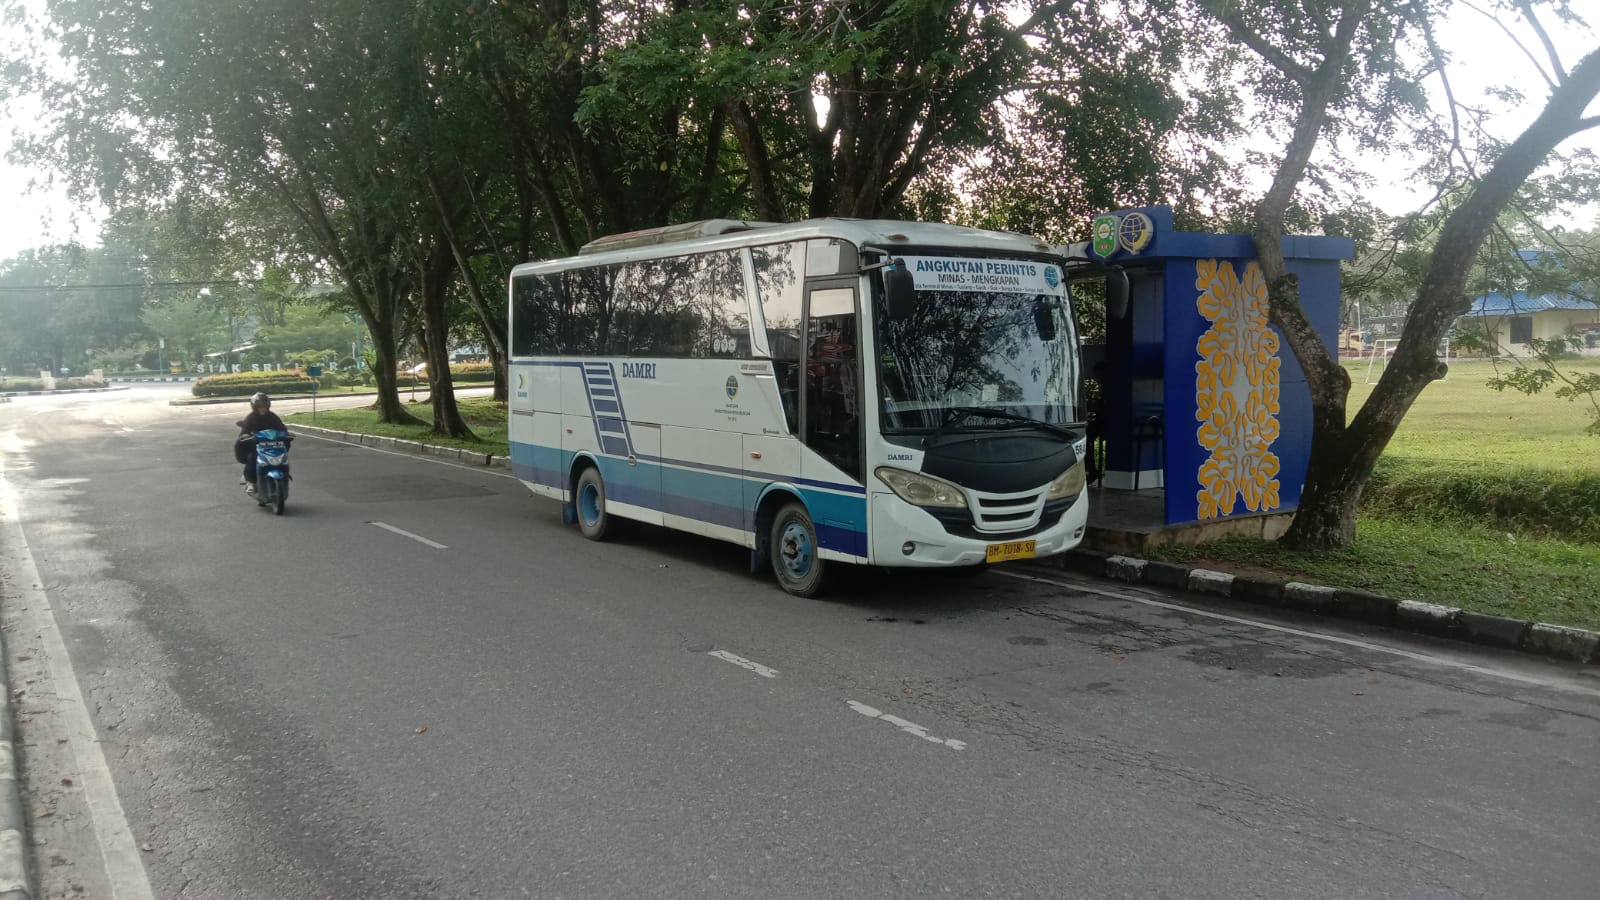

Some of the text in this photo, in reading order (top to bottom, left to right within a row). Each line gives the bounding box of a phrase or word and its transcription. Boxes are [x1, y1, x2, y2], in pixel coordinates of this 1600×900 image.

[916, 259, 1037, 277] ANGKUTAN PERINTIS
[938, 274, 966, 284] MINAS
[971, 276, 1020, 286] MENGKAPAN
[197, 363, 282, 374] SIAK SRI
[622, 362, 656, 379] DAMRI
